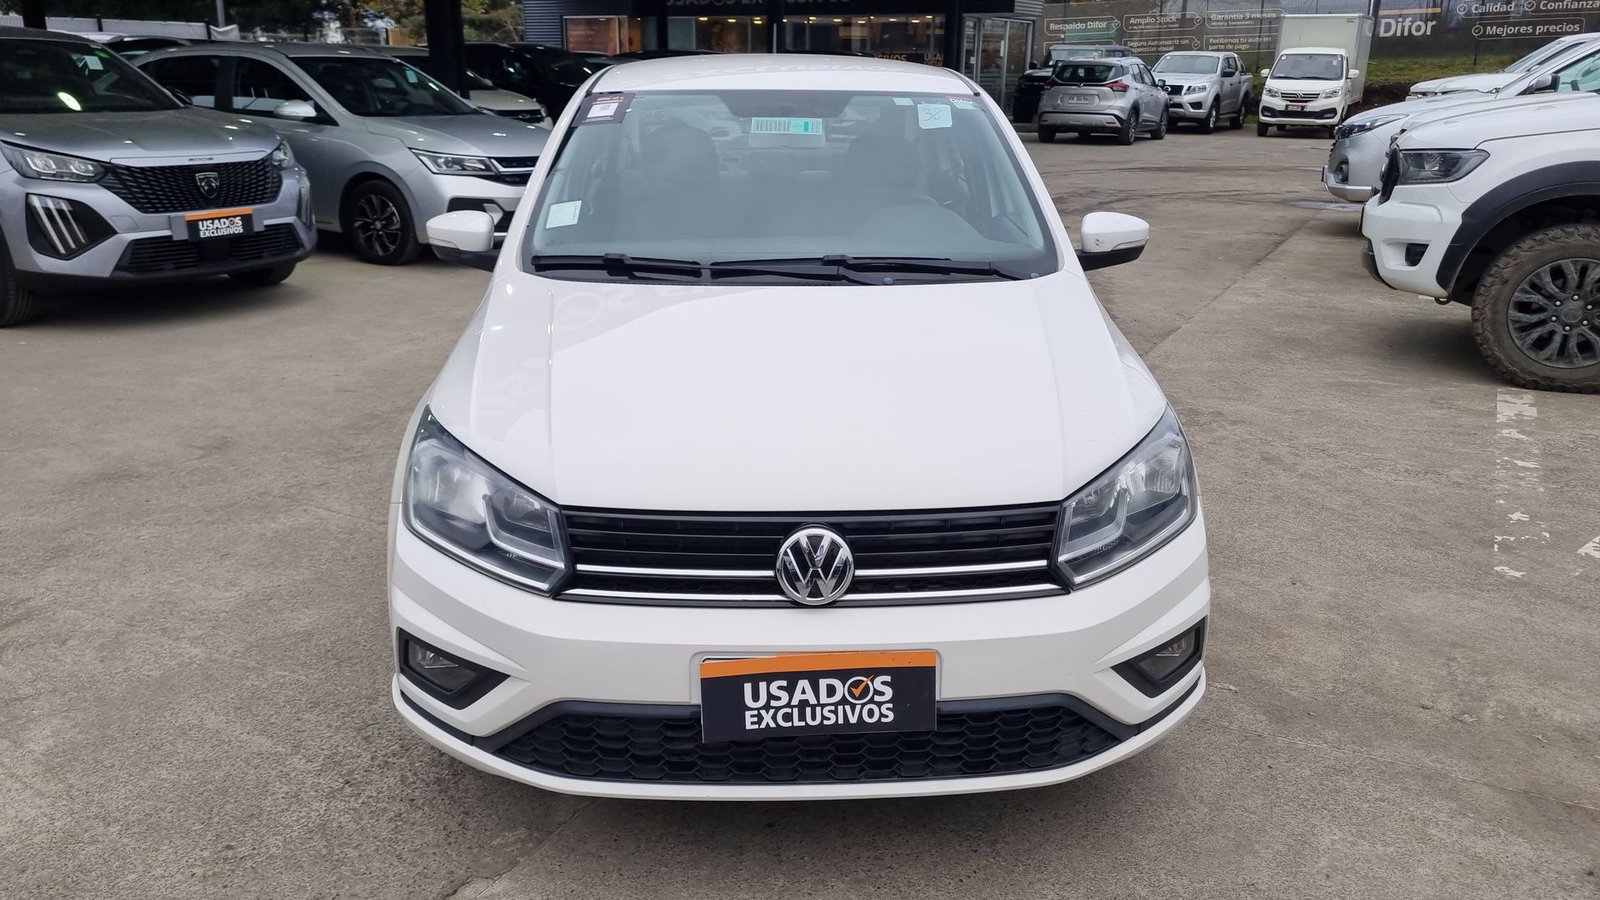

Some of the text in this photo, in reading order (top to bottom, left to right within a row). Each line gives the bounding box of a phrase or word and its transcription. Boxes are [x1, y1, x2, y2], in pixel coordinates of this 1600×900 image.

[1471, 2, 1515, 14] Calidad
[1540, 0, 1600, 10] Confianza
[1049, 20, 1108, 31] Respaldo Difor
[1129, 15, 1177, 25] Amplio Stock
[1379, 17, 1437, 38] Difor
[1486, 22, 1580, 37] Mejores precios
[198, 216, 243, 231] USADOS
[199, 226, 244, 238] EXCLUSIVOS
[743, 673, 894, 709] USADOS
[744, 702, 895, 730] EXCLUSIVOS
